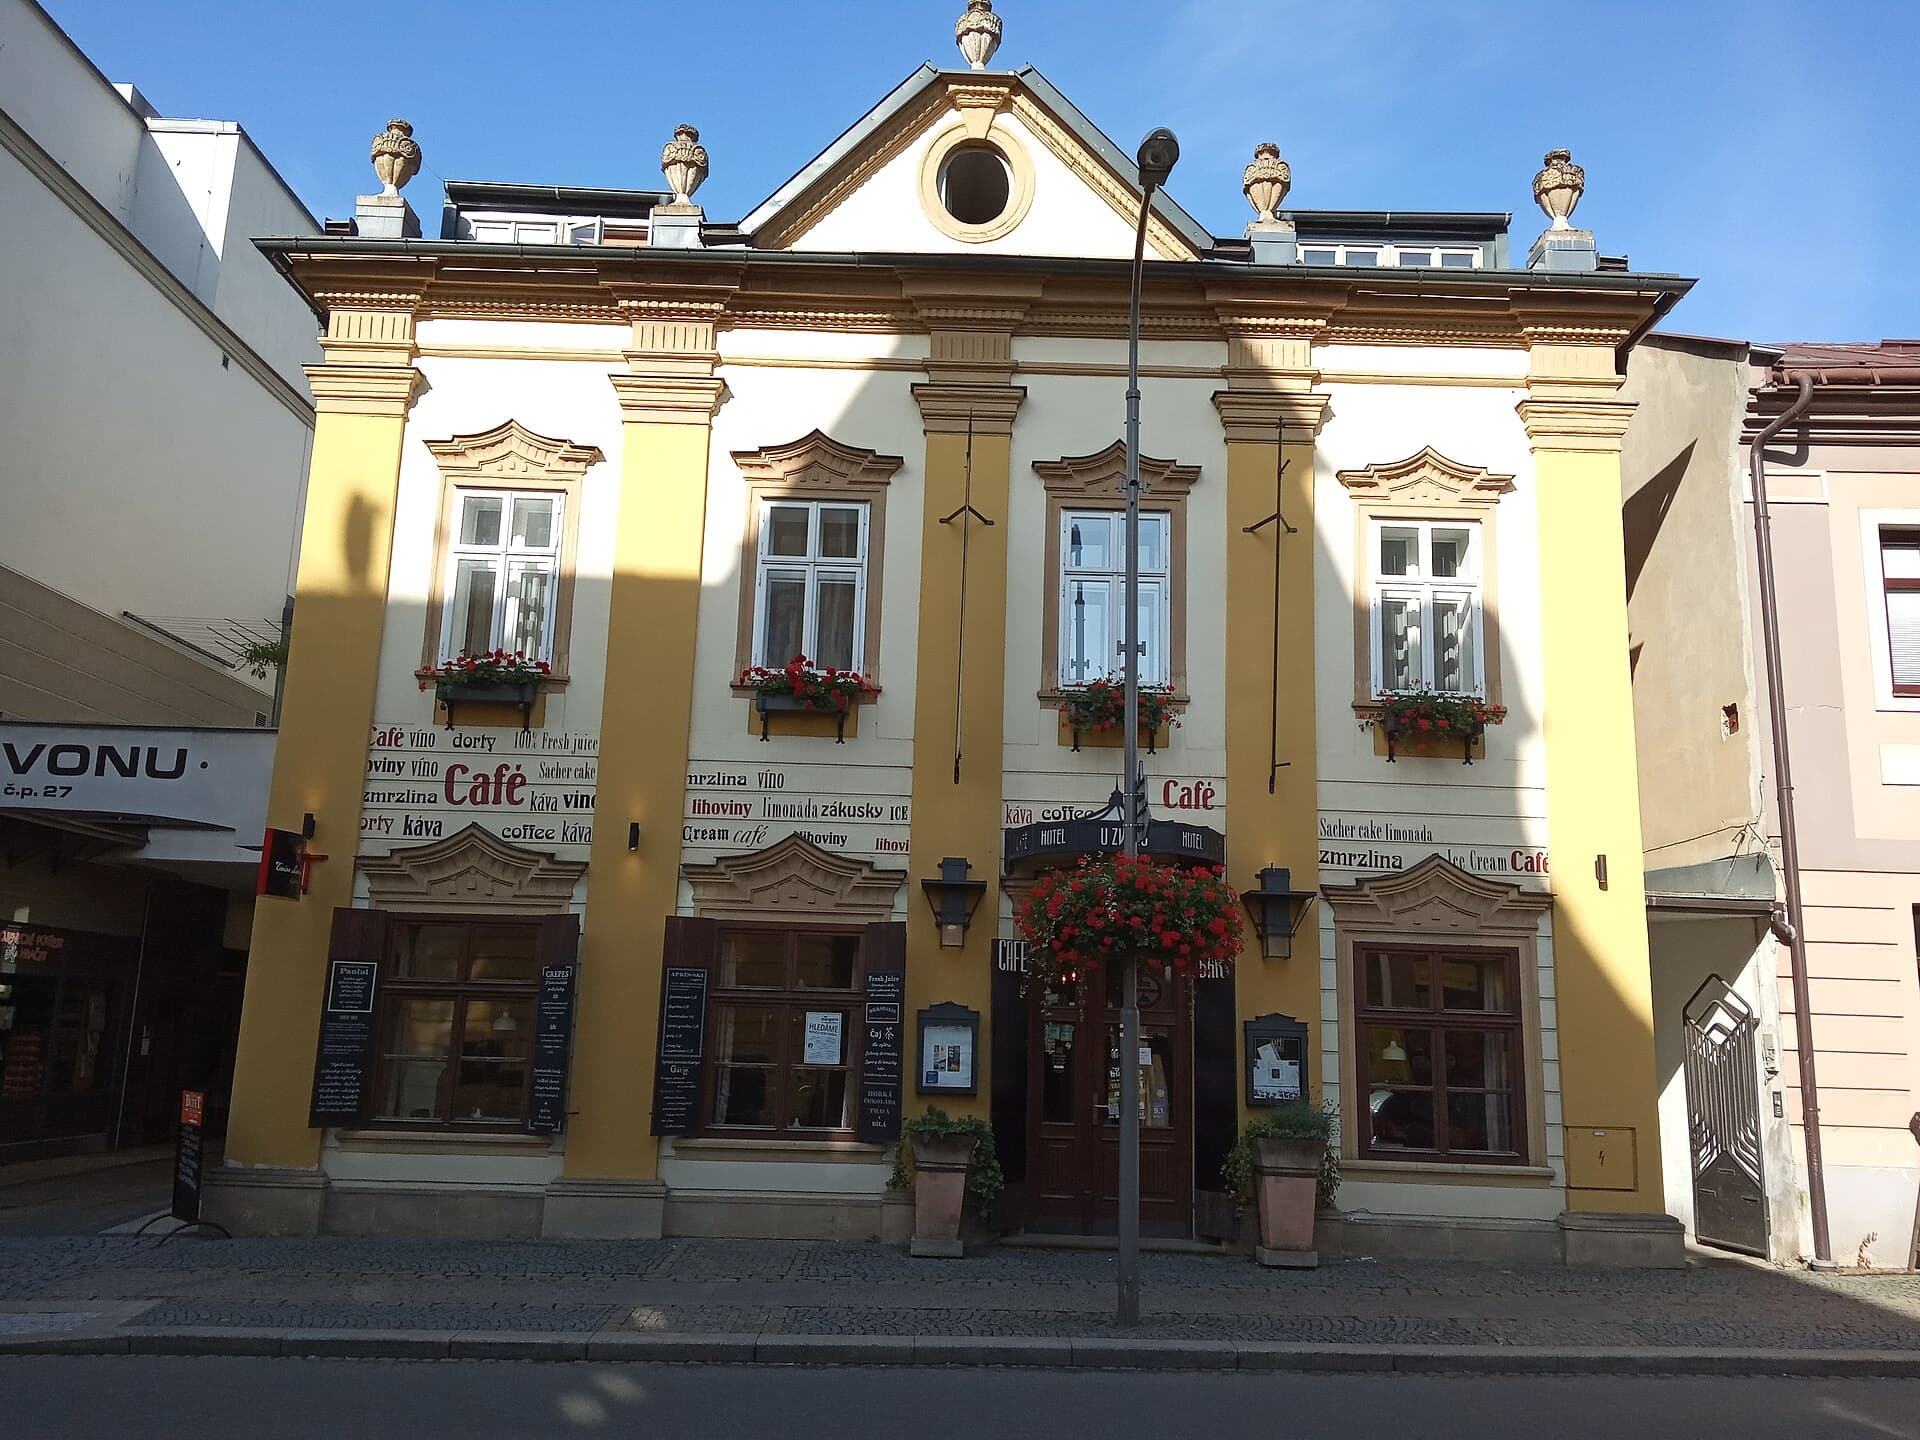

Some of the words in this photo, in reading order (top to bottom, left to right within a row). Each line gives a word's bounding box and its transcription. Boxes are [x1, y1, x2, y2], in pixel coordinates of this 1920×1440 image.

[410, 729, 436, 747] víno
[453, 733, 497, 752] dorty
[542, 732, 570, 750] Fresh
[570, 733, 598, 754] juice
[2, 743, 188, 780] VONU
[411, 758, 439, 777] víno
[444, 764, 527, 806] Café
[539, 761, 572, 778] Sacher
[573, 761, 596, 779] cake
[758, 769, 785, 788] víno
[4, 783, 38, 799] č.p.
[43, 785, 73, 798] 27
[529, 790, 558, 811] káva
[1163, 780, 1216, 811] Café
[692, 799, 753, 818] lihoviny
[762, 796, 818, 818] limonáda
[820, 801, 883, 819] zákusky
[1006, 804, 1033, 824] káva
[403, 814, 443, 837] káva
[501, 824, 556, 840] coffee
[561, 820, 593, 842] káva
[733, 824, 769, 848] café
[1040, 828, 1067, 847] HOTEL
[1100, 827, 1109, 846] U
[1320, 818, 1356, 839] Sacher
[1358, 819, 1383, 840] cake
[1385, 823, 1433, 842] limonáda
[1182, 831, 1204, 850] HOTEL
[1319, 849, 1404, 870] zmrzlina
[1470, 849, 1507, 872] Cream
[809, 1022, 839, 1034] HLEDÁME
[870, 1027, 882, 1040] Čaj
